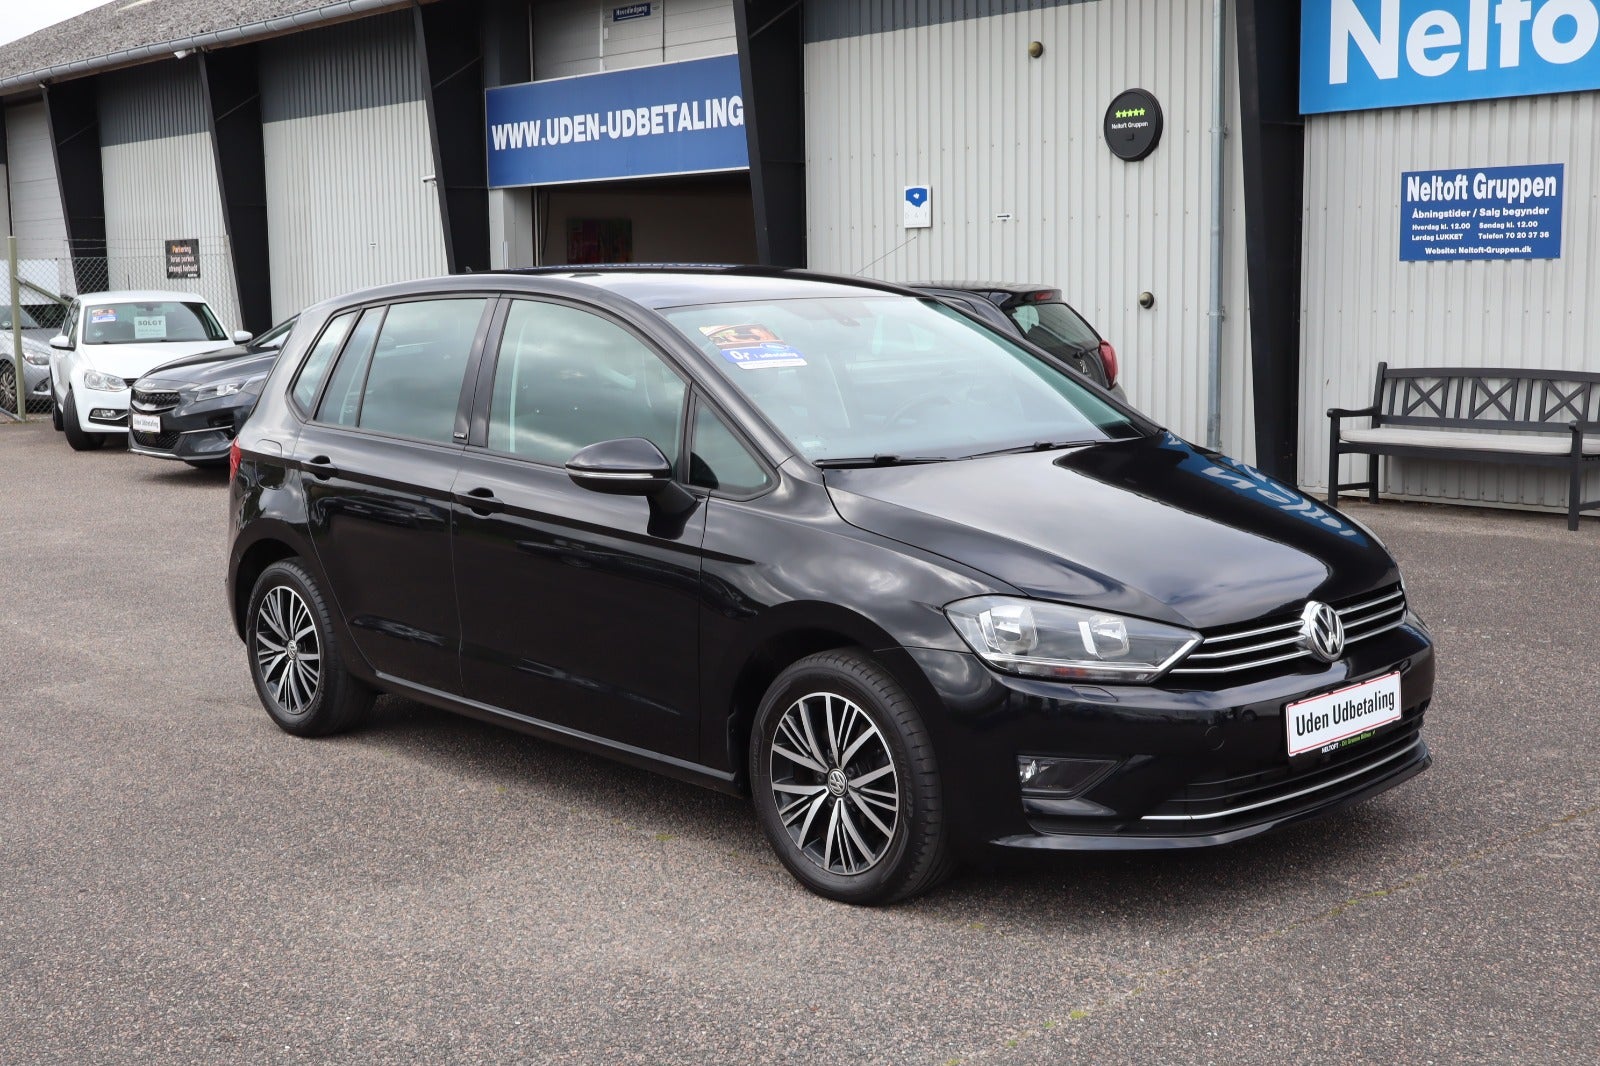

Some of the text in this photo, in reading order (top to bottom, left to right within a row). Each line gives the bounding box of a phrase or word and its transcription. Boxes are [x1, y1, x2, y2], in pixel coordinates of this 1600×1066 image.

[491, 95, 743, 151] WWW.UDEN-UDBETALING
[1111, 121, 1149, 130] Neltoft Gruppen
[1407, 172, 1557, 204] Neltoft Gruppen
[1412, 207, 1471, 220] Åbningstider
[1479, 207, 1501, 218] Salg
[1503, 206, 1550, 217] begynder
[1450, 222, 1471, 230] 12.00
[1517, 220, 1538, 228] 12.00
[1411, 234, 1434, 242] Lørdag
[1516, 231, 1527, 239] 20
[1424, 245, 1532, 255] Website: Neltoft-Gruppen.dk
[1295, 690, 1395, 737] Uden Udbetaling
